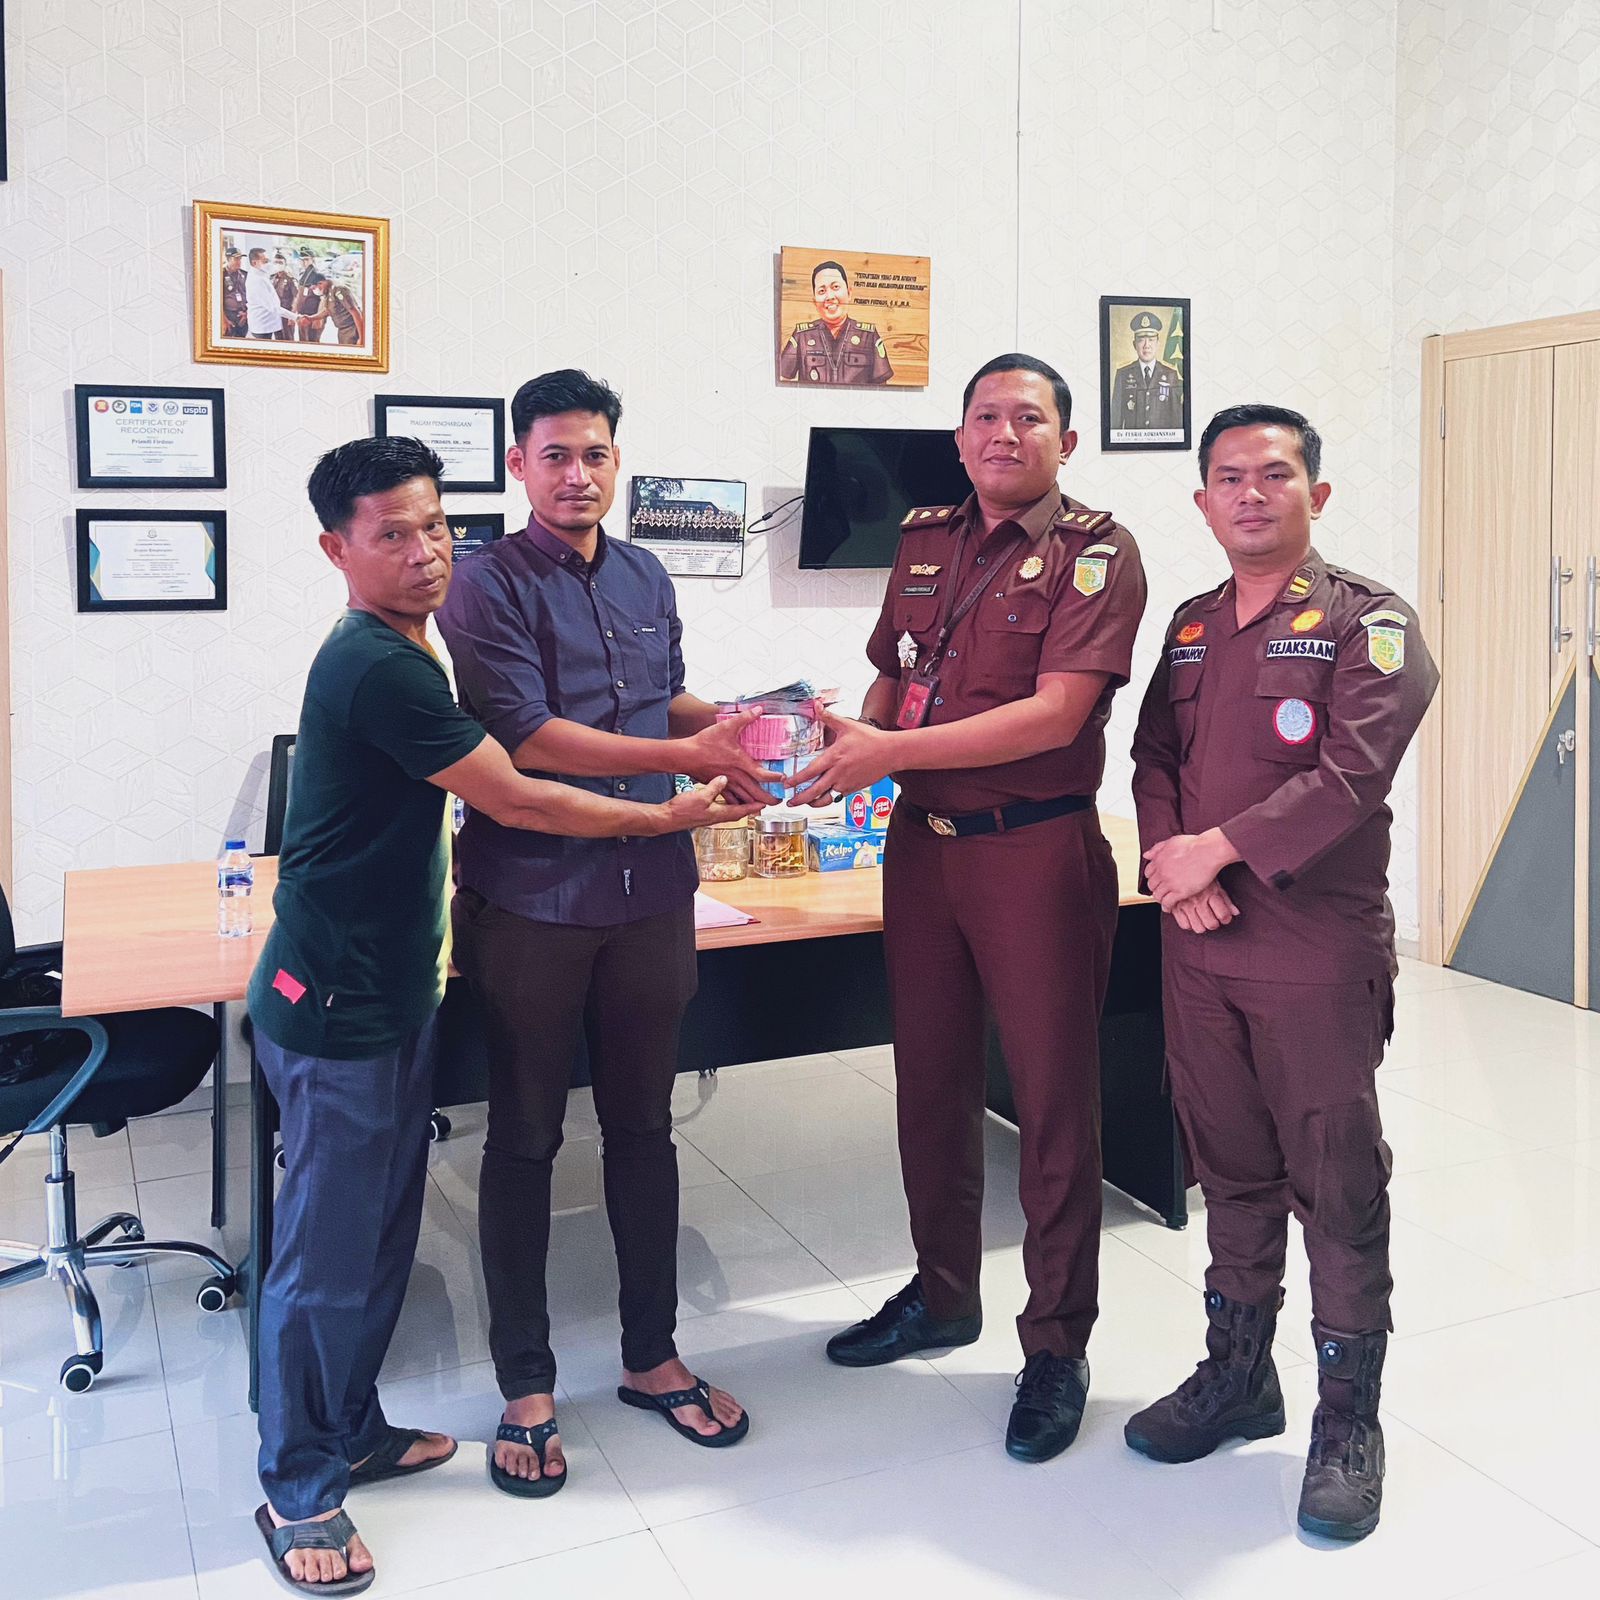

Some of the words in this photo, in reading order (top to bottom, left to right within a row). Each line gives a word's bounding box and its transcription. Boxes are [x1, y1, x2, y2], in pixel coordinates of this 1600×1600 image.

[184, 407, 207, 415] uspto
[115, 418, 174, 426] CERTIFICATE
[1267, 641, 1334, 658] KEJAKSAAN
